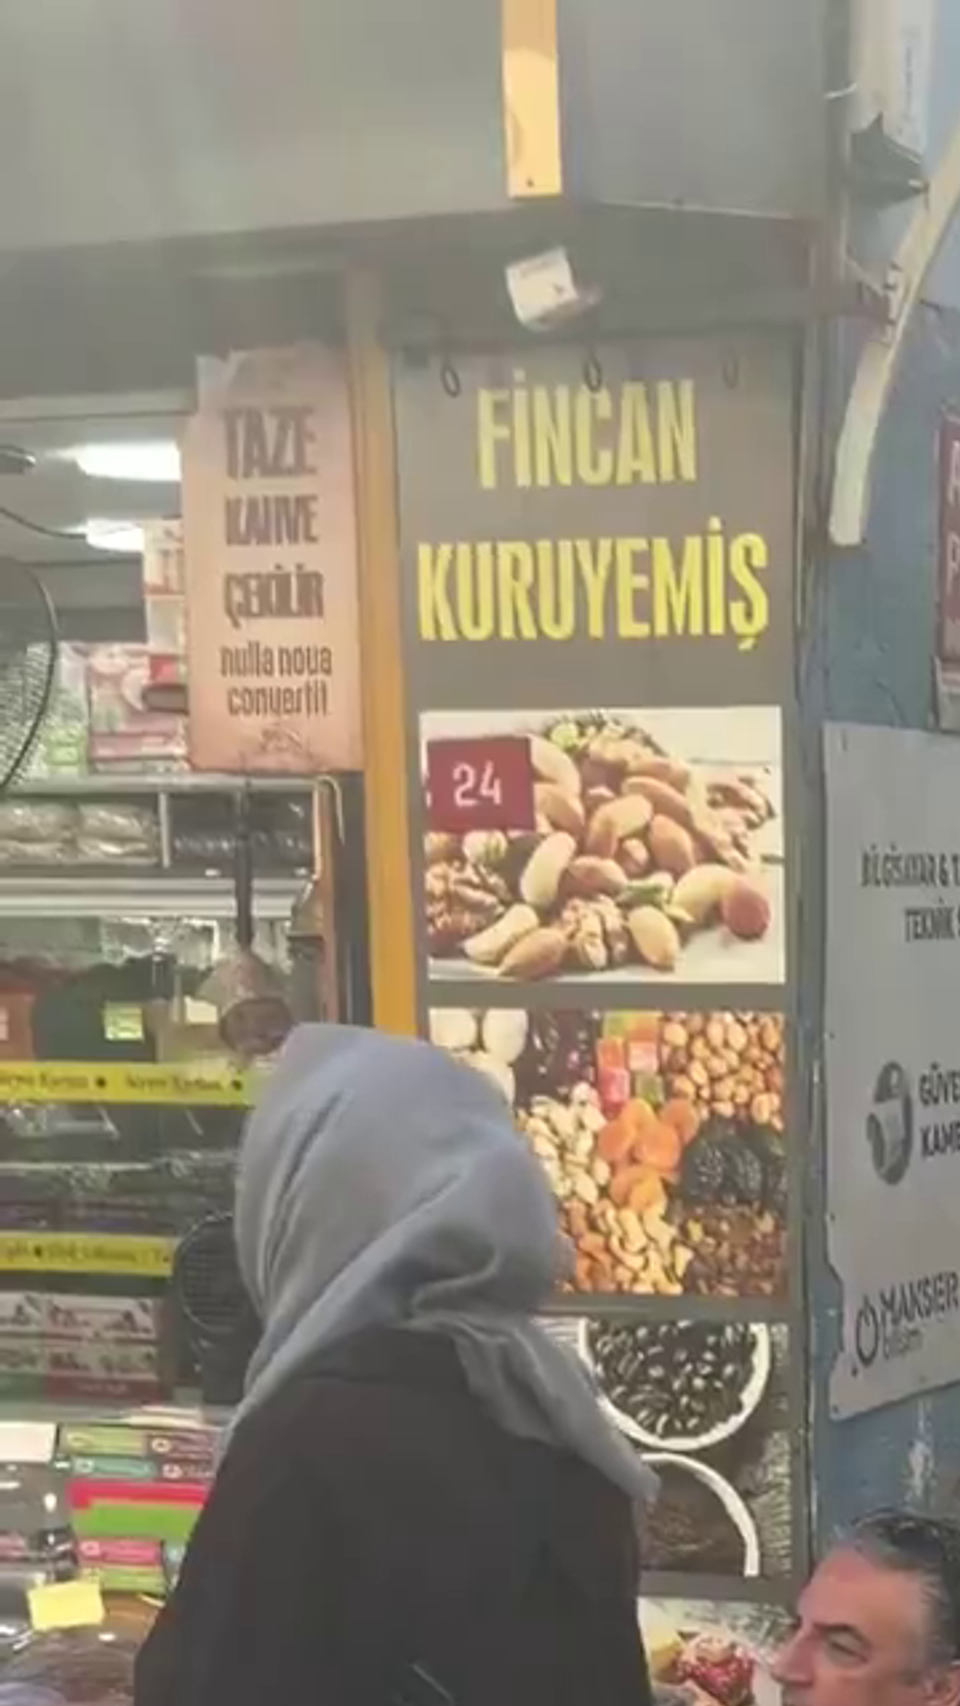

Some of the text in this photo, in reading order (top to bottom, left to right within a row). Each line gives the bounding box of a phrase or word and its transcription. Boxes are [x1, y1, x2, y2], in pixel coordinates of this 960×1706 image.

[222, 406, 318, 481] TAZE
[477, 368, 697, 489] FİNCAN
[417, 516, 769, 651] KURUYEMİŞ
[452, 761, 503, 807] 24
